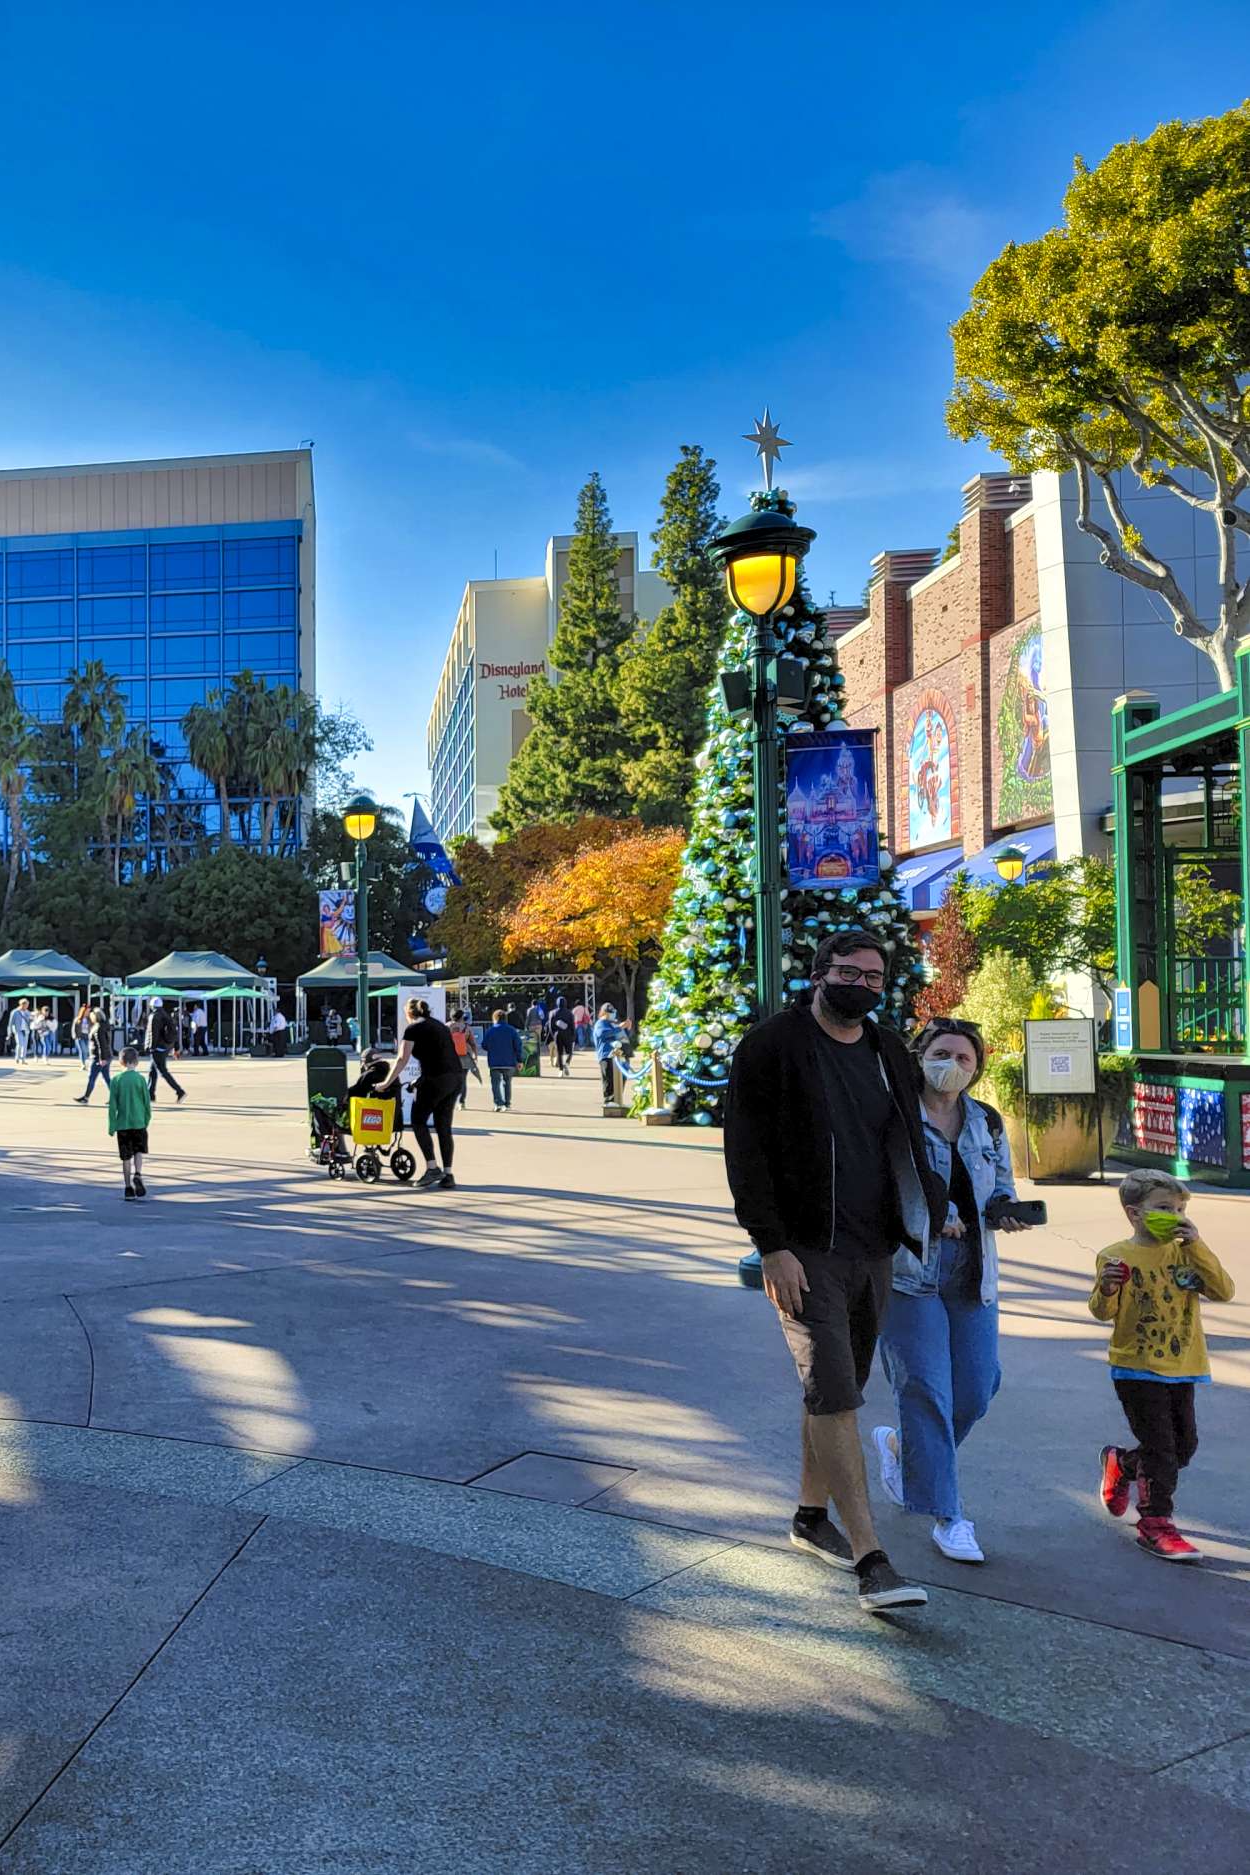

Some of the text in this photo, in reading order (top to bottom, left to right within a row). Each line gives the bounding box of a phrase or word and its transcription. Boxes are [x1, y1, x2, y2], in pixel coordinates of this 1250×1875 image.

[478, 660, 546, 679] Disneyland
[497, 683, 529, 700] Hotel
[363, 1115, 382, 1125] LEGO
